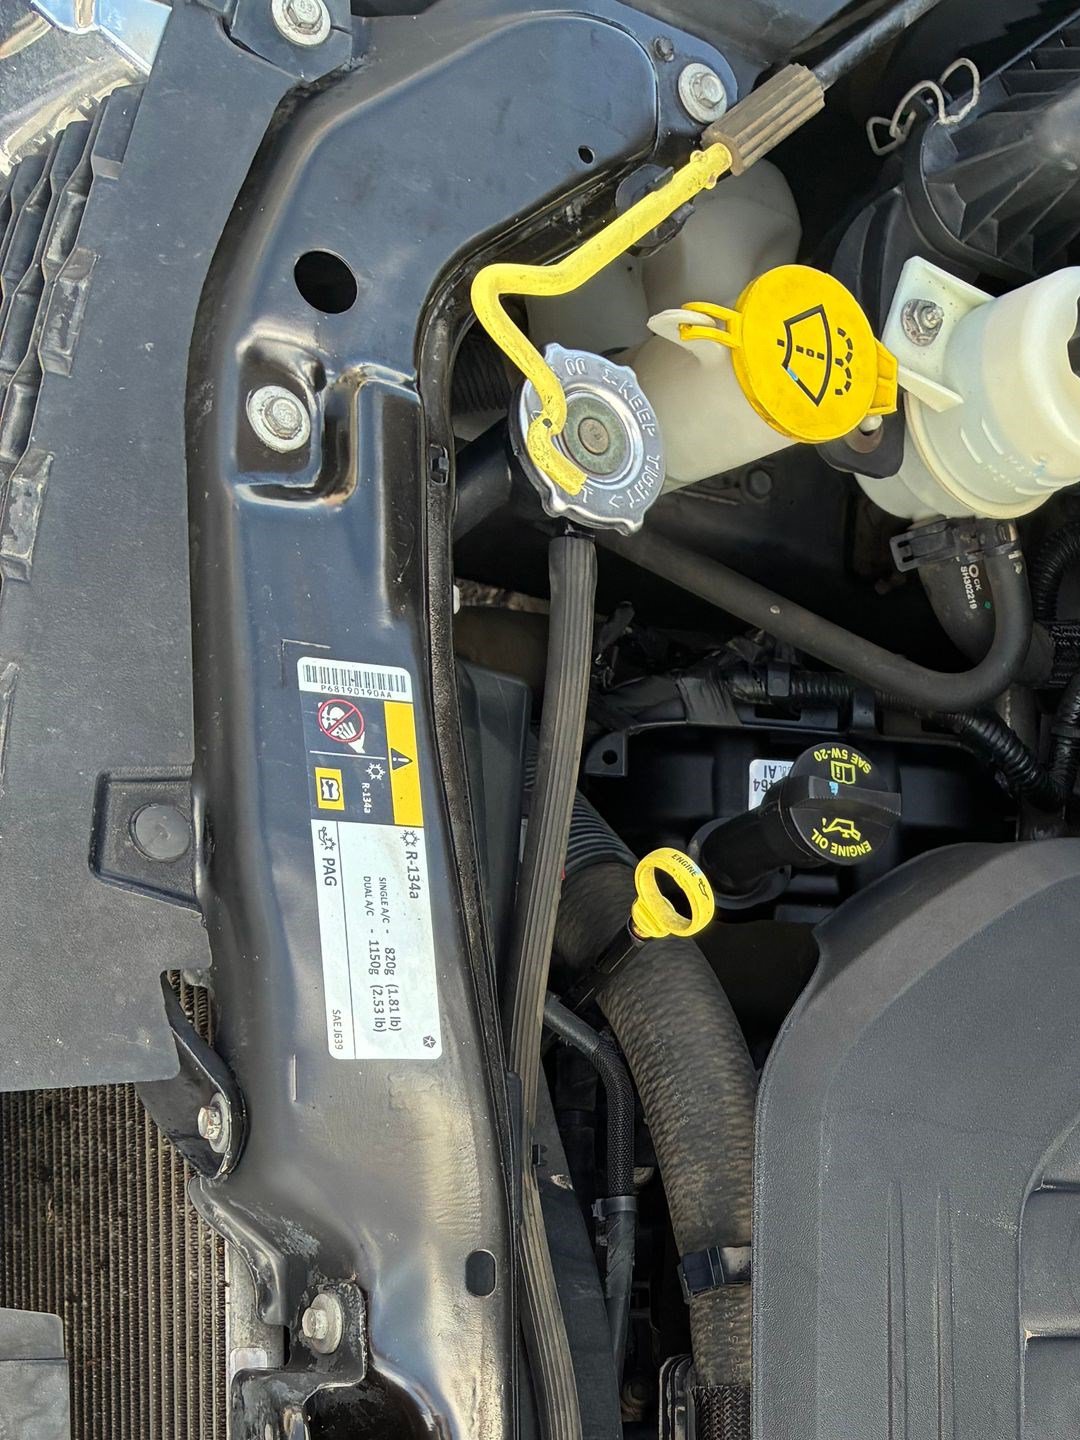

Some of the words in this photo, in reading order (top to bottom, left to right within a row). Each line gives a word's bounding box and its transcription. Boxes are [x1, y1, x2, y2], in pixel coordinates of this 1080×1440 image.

[618, 380, 656, 436] KEEP
[626, 455, 660, 509] TIGHT
[321, 684, 392, 698] P68190190AA
[813, 748, 848, 761] 5W-20
[850, 756, 872, 774] SAE
[361, 782, 371, 813] R-134a
[811, 828, 830, 849] OIL
[830, 840, 872, 857] ENGINE
[322, 858, 337, 887] PAG
[406, 851, 421, 899] R-134a
[672, 853, 697, 877] ENGINE
[363, 876, 373, 898] DUAL
[379, 877, 390, 906] SINGLE
[365, 900, 374, 916] A/C
[380, 908, 390, 923] A/C
[368, 940, 380, 975] 1150g
[384, 947, 396, 976] 820g
[370, 984, 384, 1014] (2.53
[386, 984, 400, 1012] (1.81
[332, 1009, 342, 1027] SAE
[373, 1017, 386, 1032] lb)
[388, 1016, 402, 1032] lb)
[333, 1029, 343, 1050] J639
